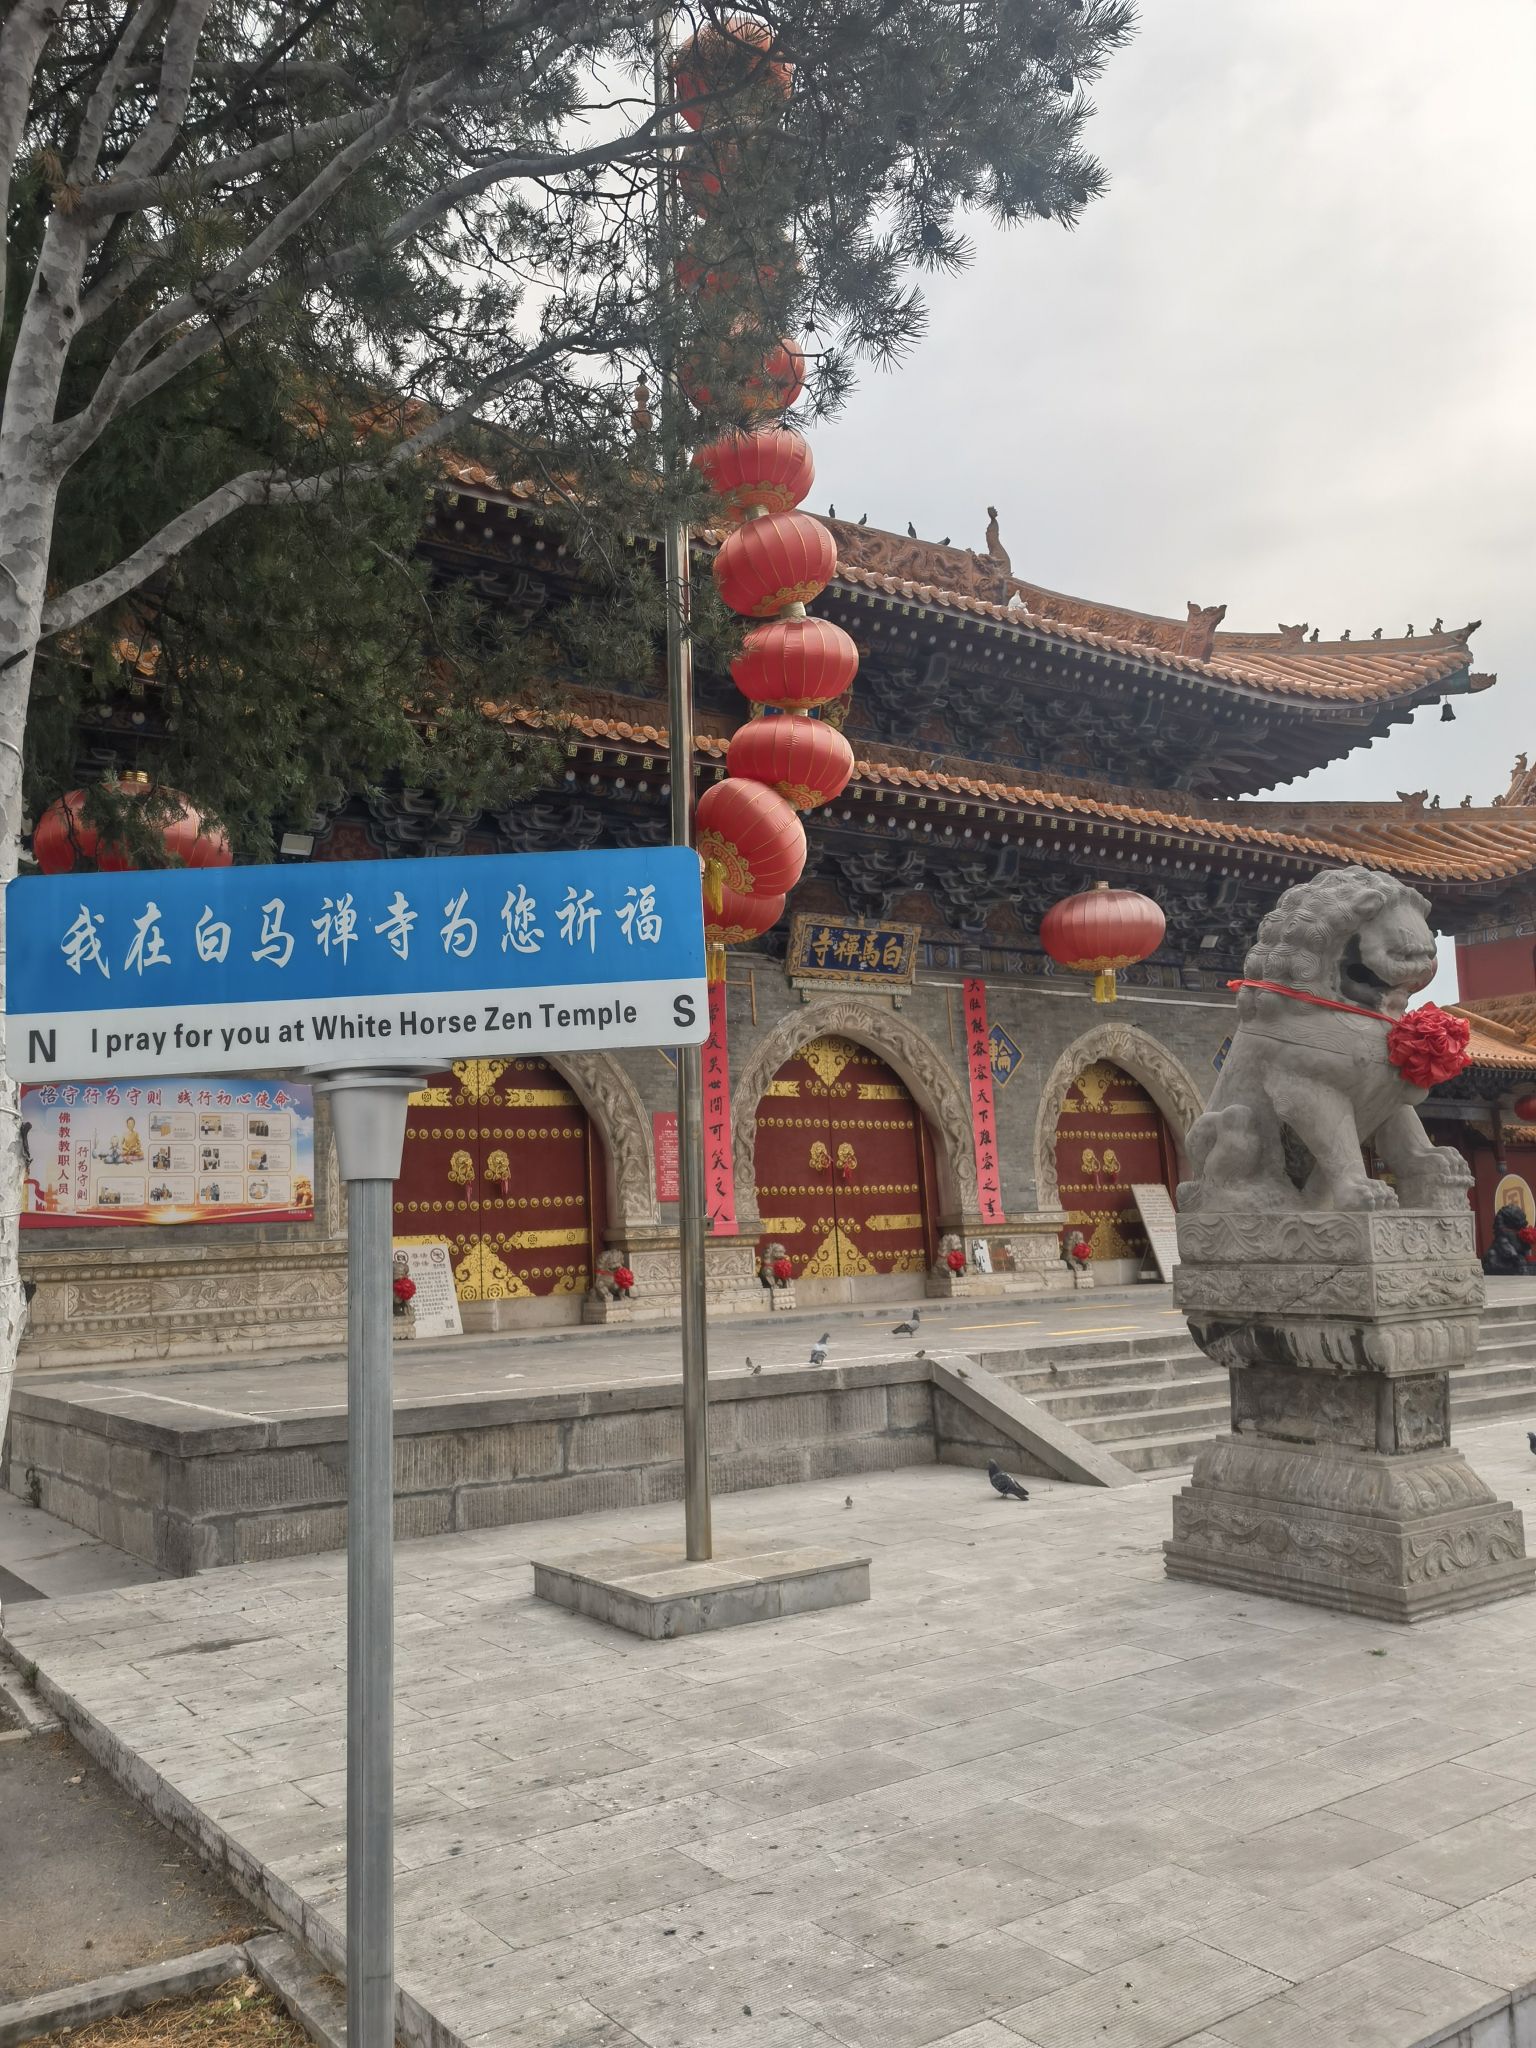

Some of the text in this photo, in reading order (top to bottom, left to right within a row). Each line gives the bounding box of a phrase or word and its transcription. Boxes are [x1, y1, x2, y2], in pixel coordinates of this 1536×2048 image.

[60, 884, 663, 979] 我在白马禅寺为您祈福
[92, 1000, 636, 1057] I pray for you at White Horse Zen Temple
[674, 995, 695, 1027] S
[30, 1030, 55, 1063] N
[57, 1112, 71, 1195] 佛教教职人员
